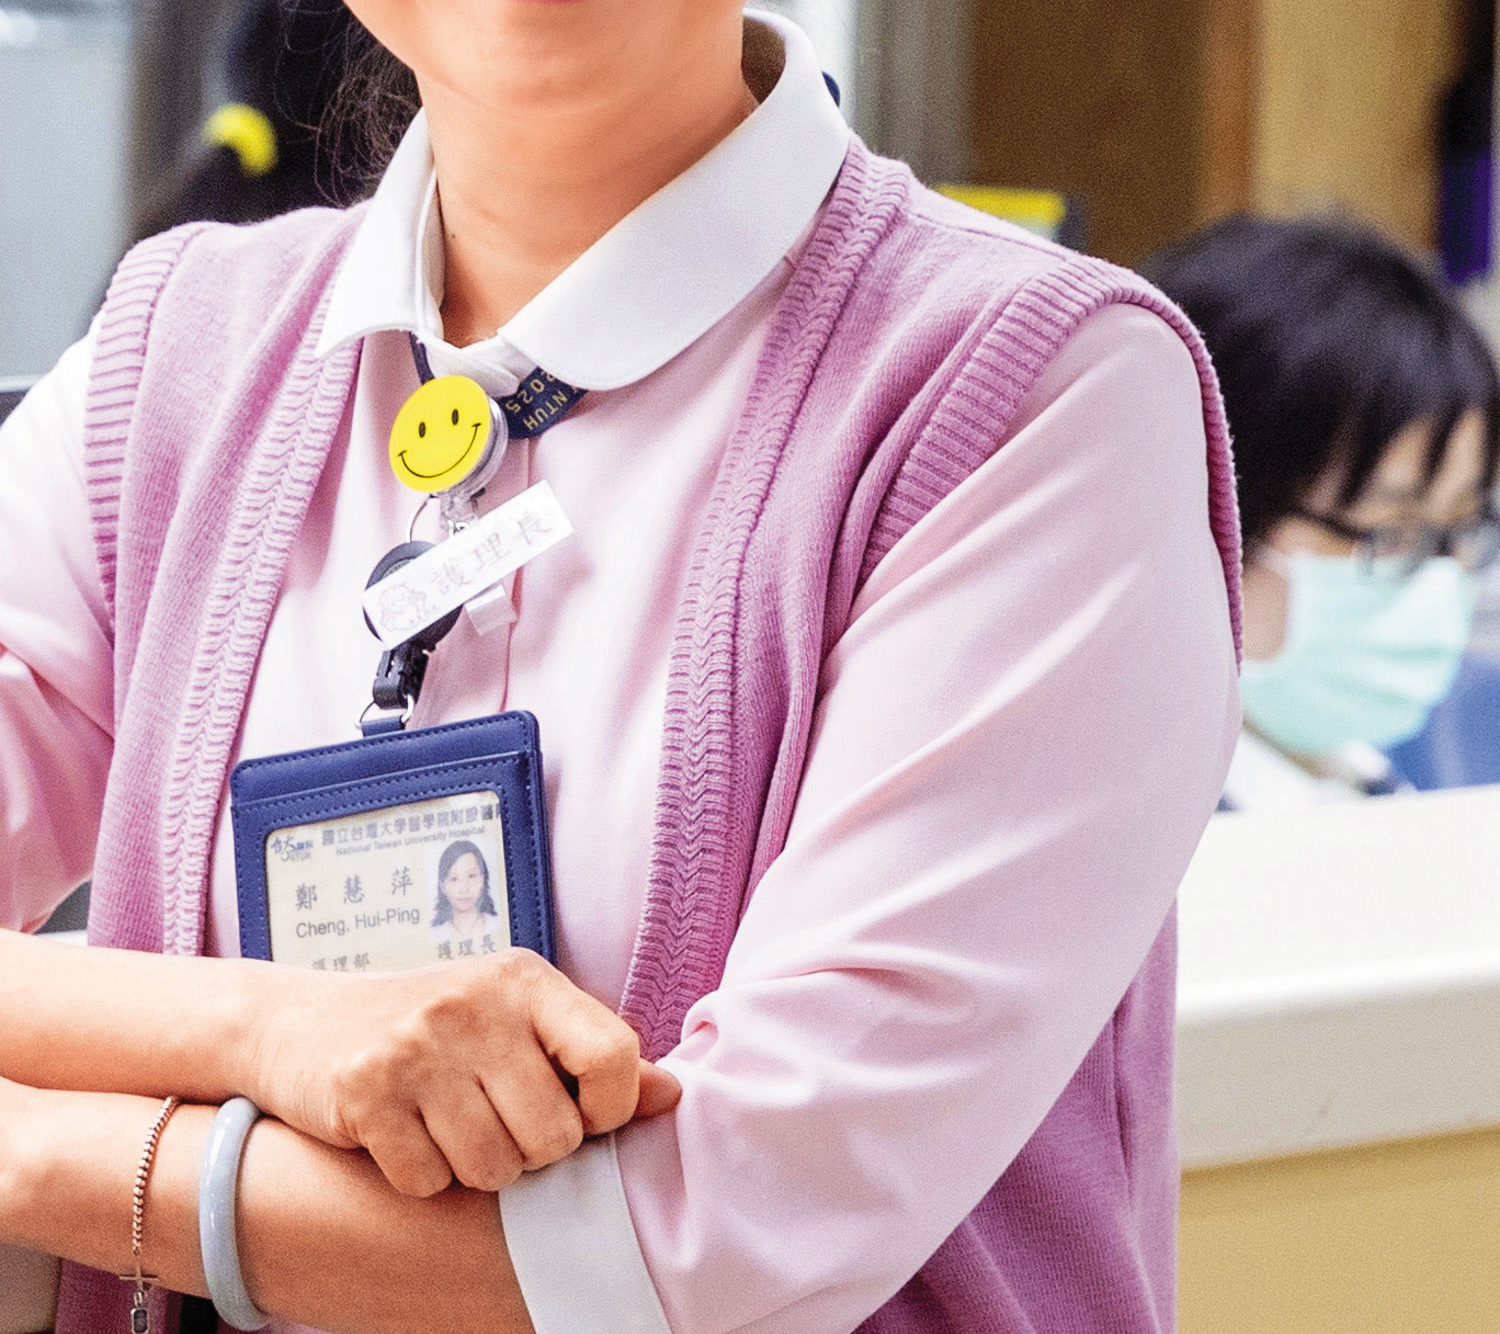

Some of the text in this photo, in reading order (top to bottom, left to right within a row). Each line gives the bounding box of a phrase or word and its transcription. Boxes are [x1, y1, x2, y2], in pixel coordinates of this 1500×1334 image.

[523, 391, 568, 430] NTUH
[296, 907, 421, 939] Cheng, Hui-Ping
